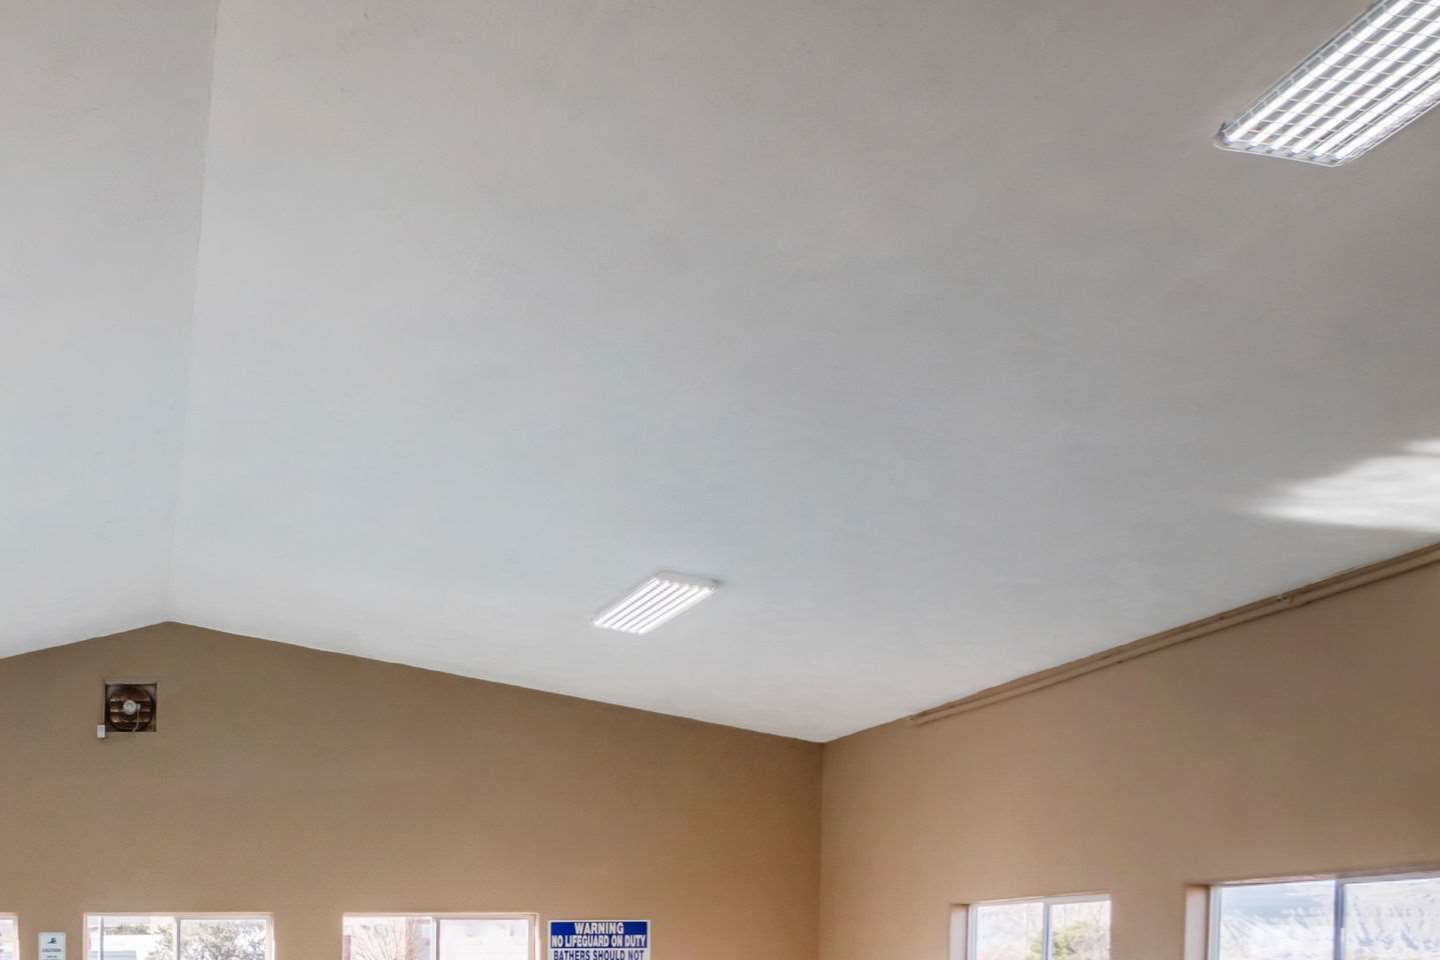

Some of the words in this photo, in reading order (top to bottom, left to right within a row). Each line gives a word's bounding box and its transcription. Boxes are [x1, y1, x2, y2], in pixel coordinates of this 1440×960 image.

[574, 922, 624, 934] WARNING
[551, 935, 563, 947] NO
[565, 935, 609, 947] LIFEGUARD
[610, 935, 623, 947] ON
[624, 935, 646, 947] DUTY
[553, 950, 590, 960] BATHERS
[593, 950, 625, 960] SHOULD
[628, 950, 644, 960] NOT
